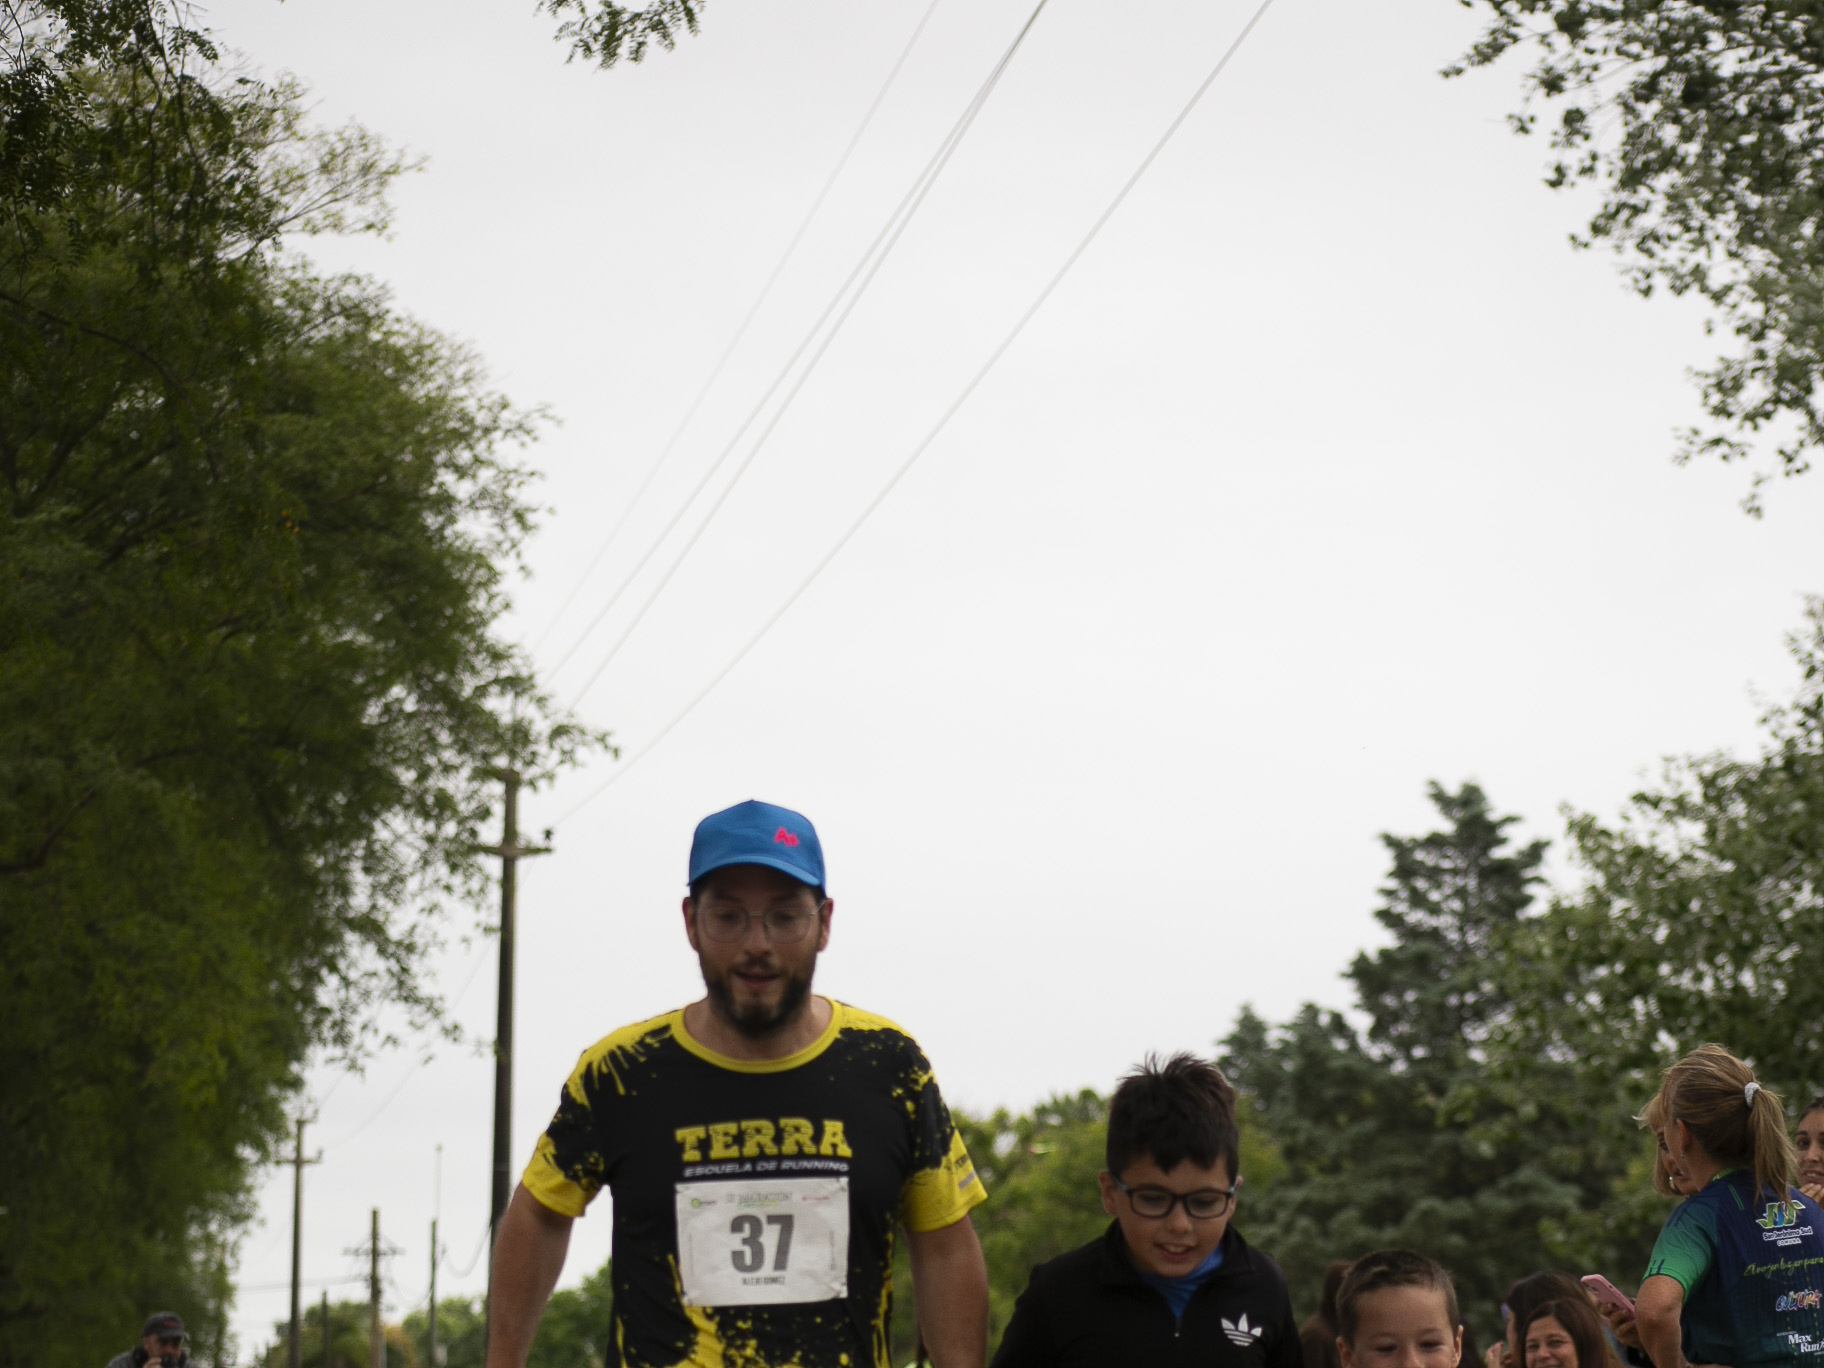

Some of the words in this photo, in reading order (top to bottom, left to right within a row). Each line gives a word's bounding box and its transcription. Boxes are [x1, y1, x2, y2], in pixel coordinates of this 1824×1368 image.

[675, 1117, 852, 1162] TERRA
[684, 1162, 752, 1177] ESCUELA
[756, 1160, 777, 1171] DE
[780, 1160, 850, 1172] RUNNING
[1763, 1232, 1774, 1240] San
[1801, 1226, 1812, 1235] Sud
[731, 1214, 794, 1274] 37
[1788, 1334, 1812, 1344] Max
